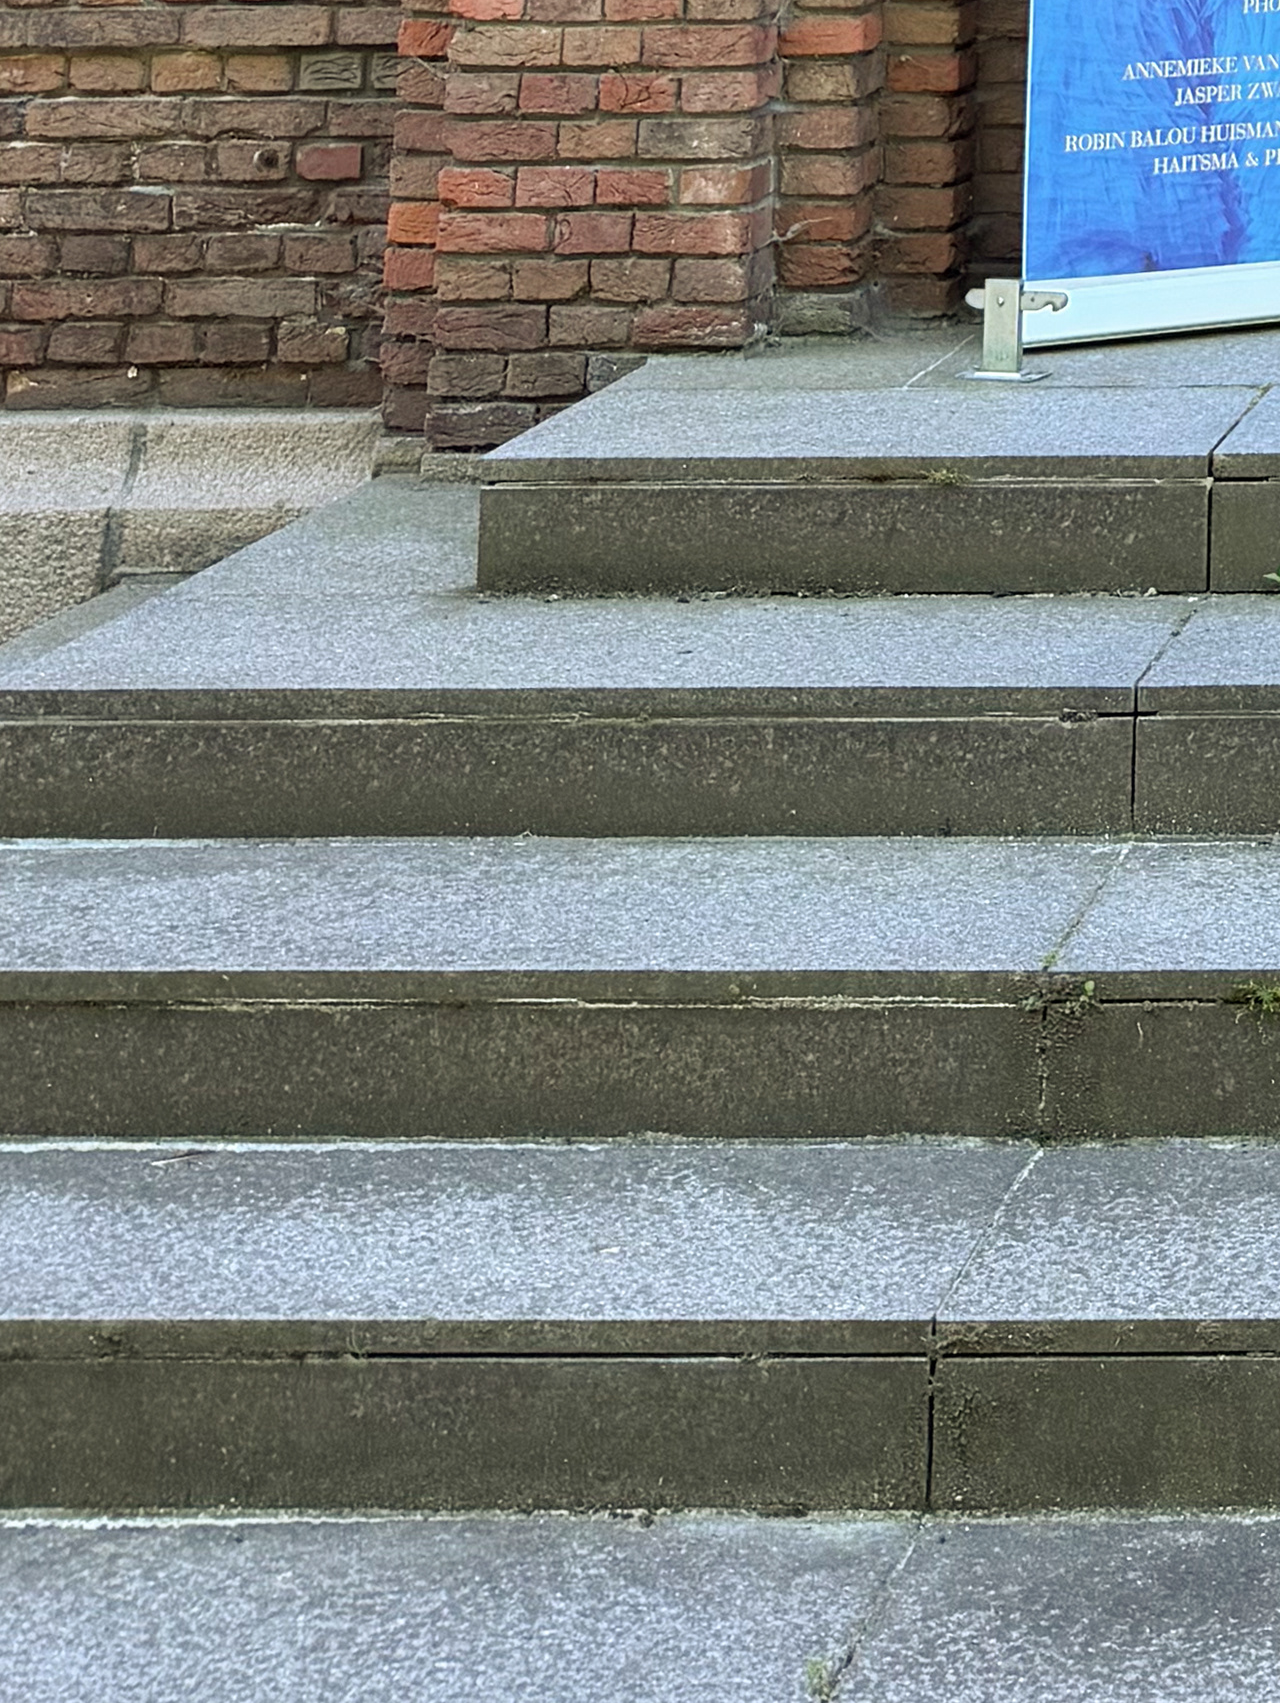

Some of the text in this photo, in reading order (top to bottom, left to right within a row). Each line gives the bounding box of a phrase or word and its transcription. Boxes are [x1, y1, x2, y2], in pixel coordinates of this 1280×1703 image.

[1122, 56, 1238, 81] ANNEMIEKE
[1243, 53, 1280, 71] VAN
[1174, 84, 1242, 106] JASPER
[1065, 131, 1125, 152] ROBIN
[1131, 126, 1196, 148] BALOU
[1153, 150, 1239, 176] HAITSMA
[1245, 151, 1259, 168] &
